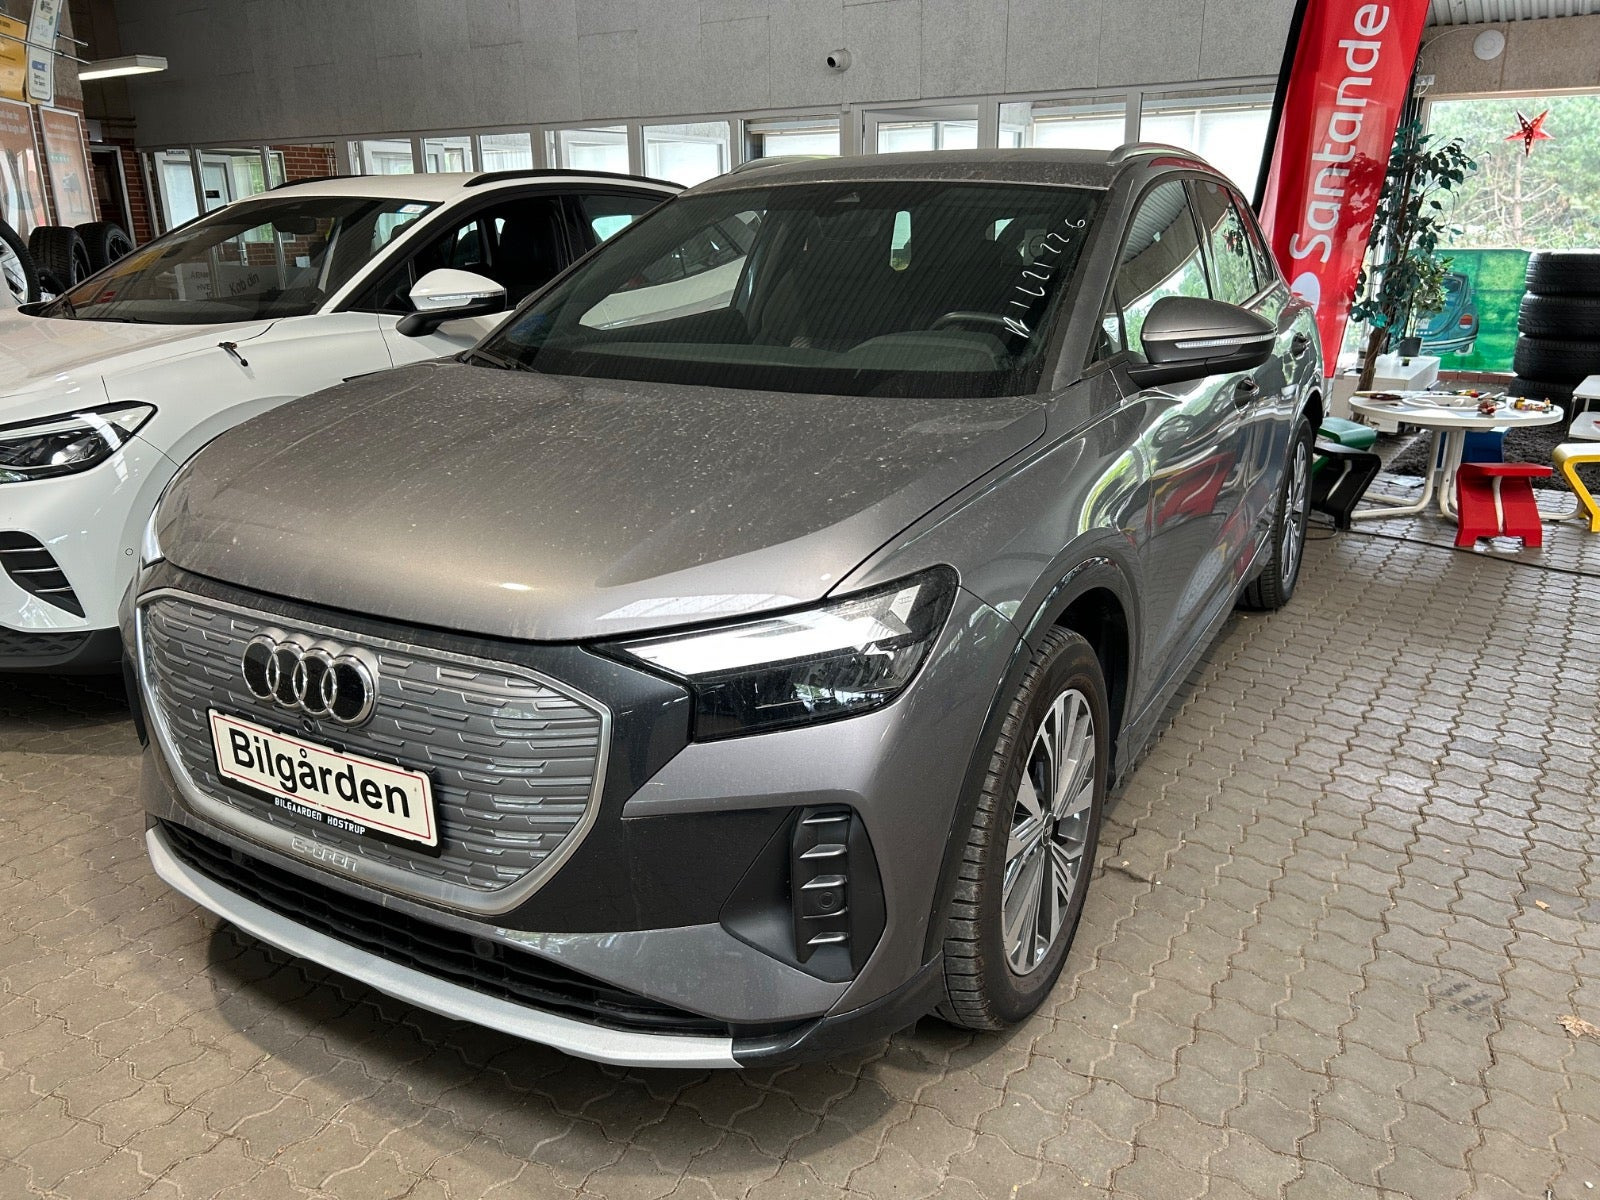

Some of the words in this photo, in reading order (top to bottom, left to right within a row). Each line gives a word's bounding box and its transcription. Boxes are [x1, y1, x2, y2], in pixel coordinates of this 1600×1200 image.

[1289, 3, 1390, 264] Santande
[228, 727, 410, 818] Bilgården
[274, 797, 322, 822] BILGAARDEN
[327, 816, 366, 835] HOSTRUP
[291, 836, 358, 873] e-tron
